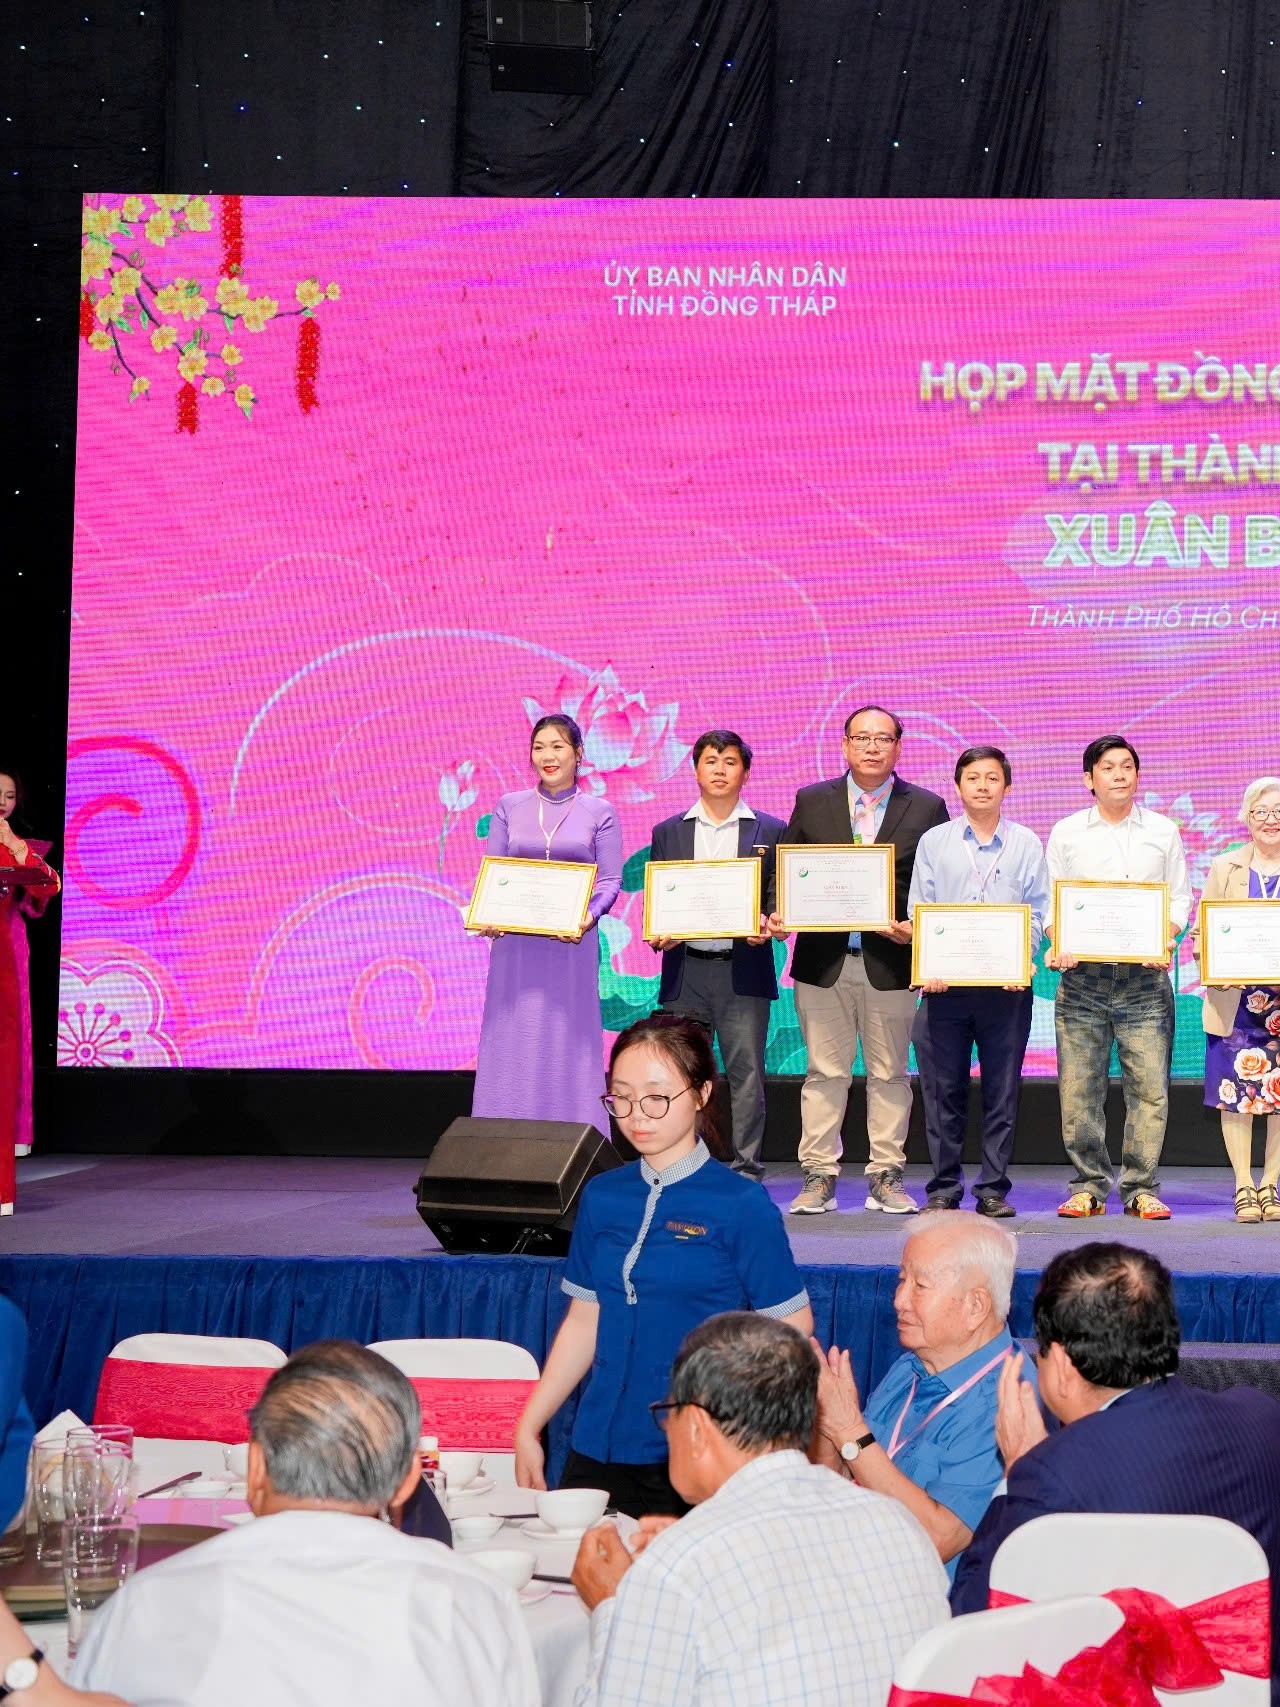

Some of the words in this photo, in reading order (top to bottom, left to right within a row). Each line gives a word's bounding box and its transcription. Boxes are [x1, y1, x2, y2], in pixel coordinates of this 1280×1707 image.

[648, 266, 700, 287] BAN
[709, 261, 784, 287] NHÂN
[792, 261, 847, 287] DÂN
[612, 289, 674, 317] TỈNH
[681, 289, 758, 317] ĐỒNG
[766, 290, 837, 317] THÁP
[920, 362, 1027, 412] HỌP
[1036, 352, 1150, 412] MẶT
[1037, 442, 1119, 493] TẠI
[1043, 500, 1231, 569] XUÂN
